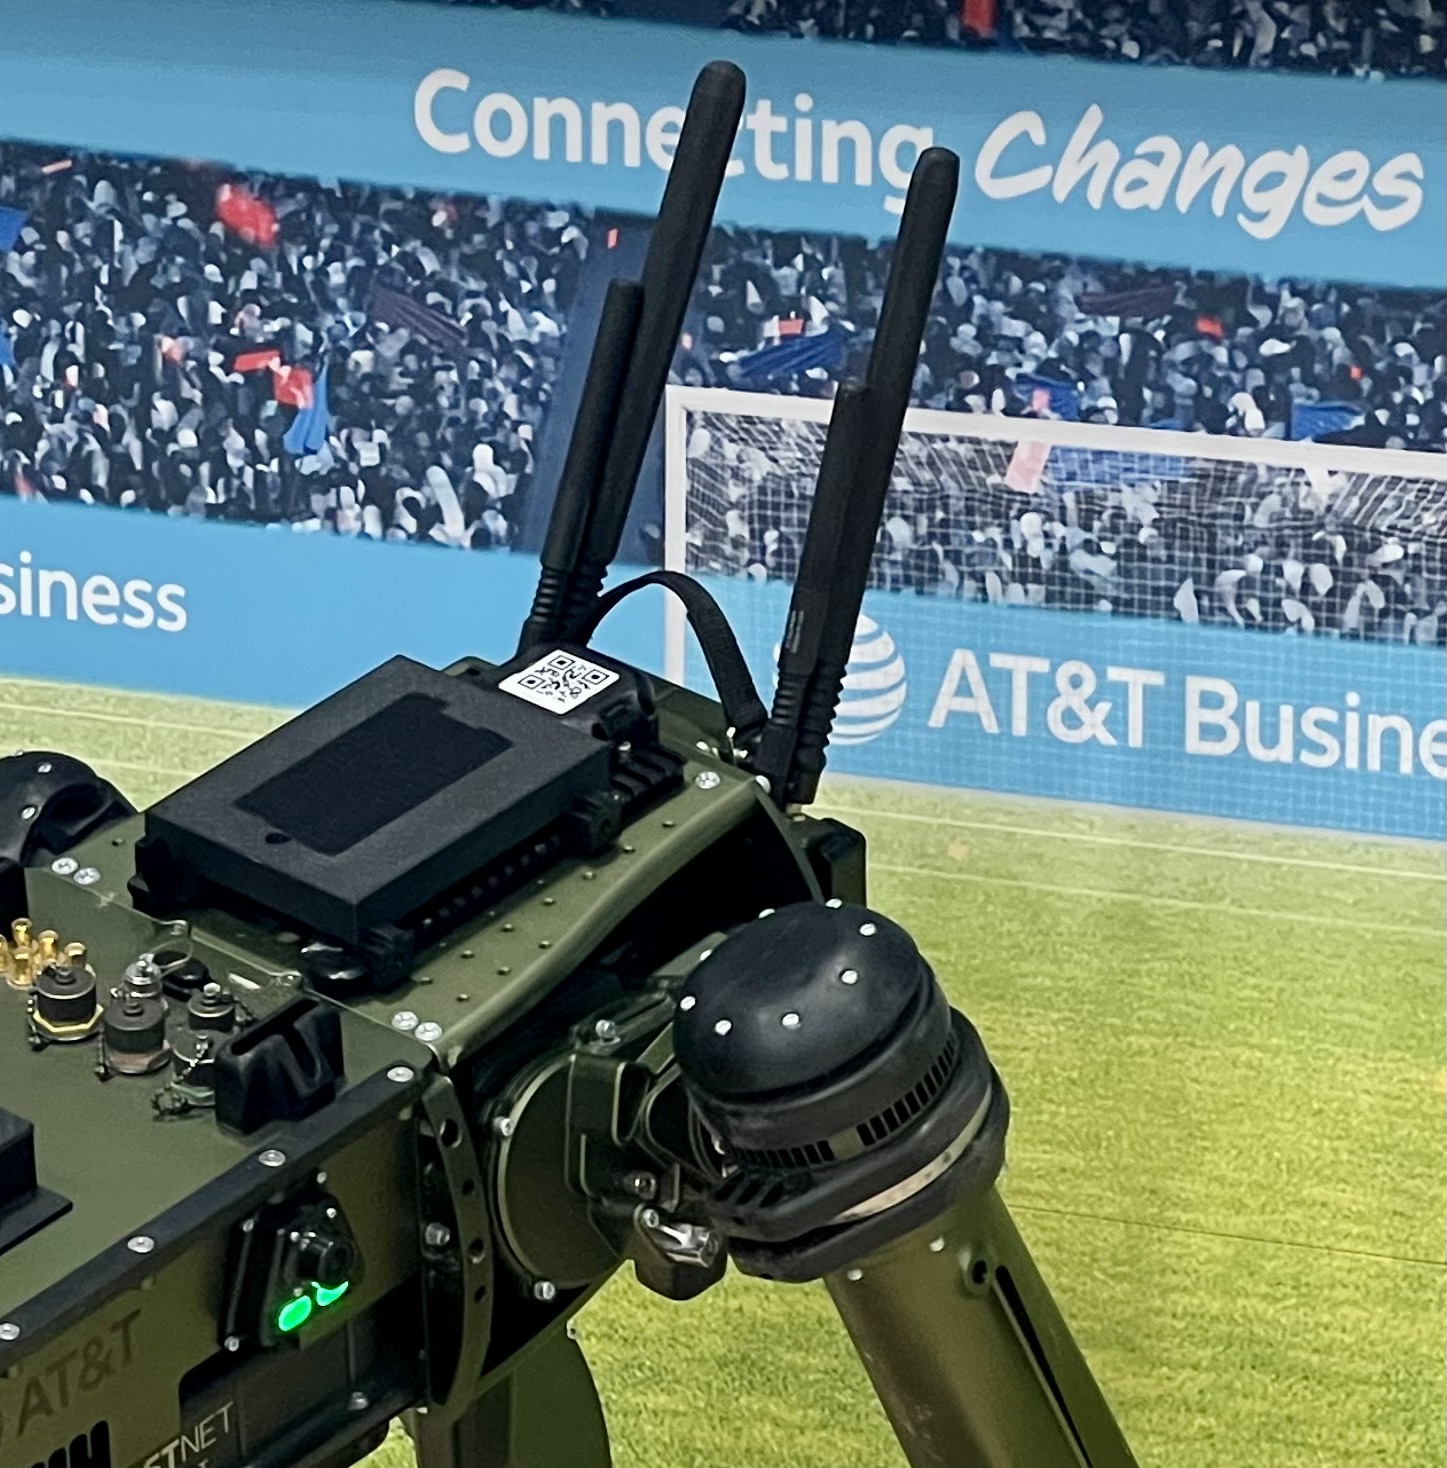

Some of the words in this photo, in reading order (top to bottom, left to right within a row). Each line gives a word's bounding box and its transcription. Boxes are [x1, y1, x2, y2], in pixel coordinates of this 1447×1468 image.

[414, 68, 934, 215] Conneting
[975, 103, 1424, 240] Changes
[927, 648, 1165, 748] AT&T
[18, 1308, 141, 1436] AT&T
